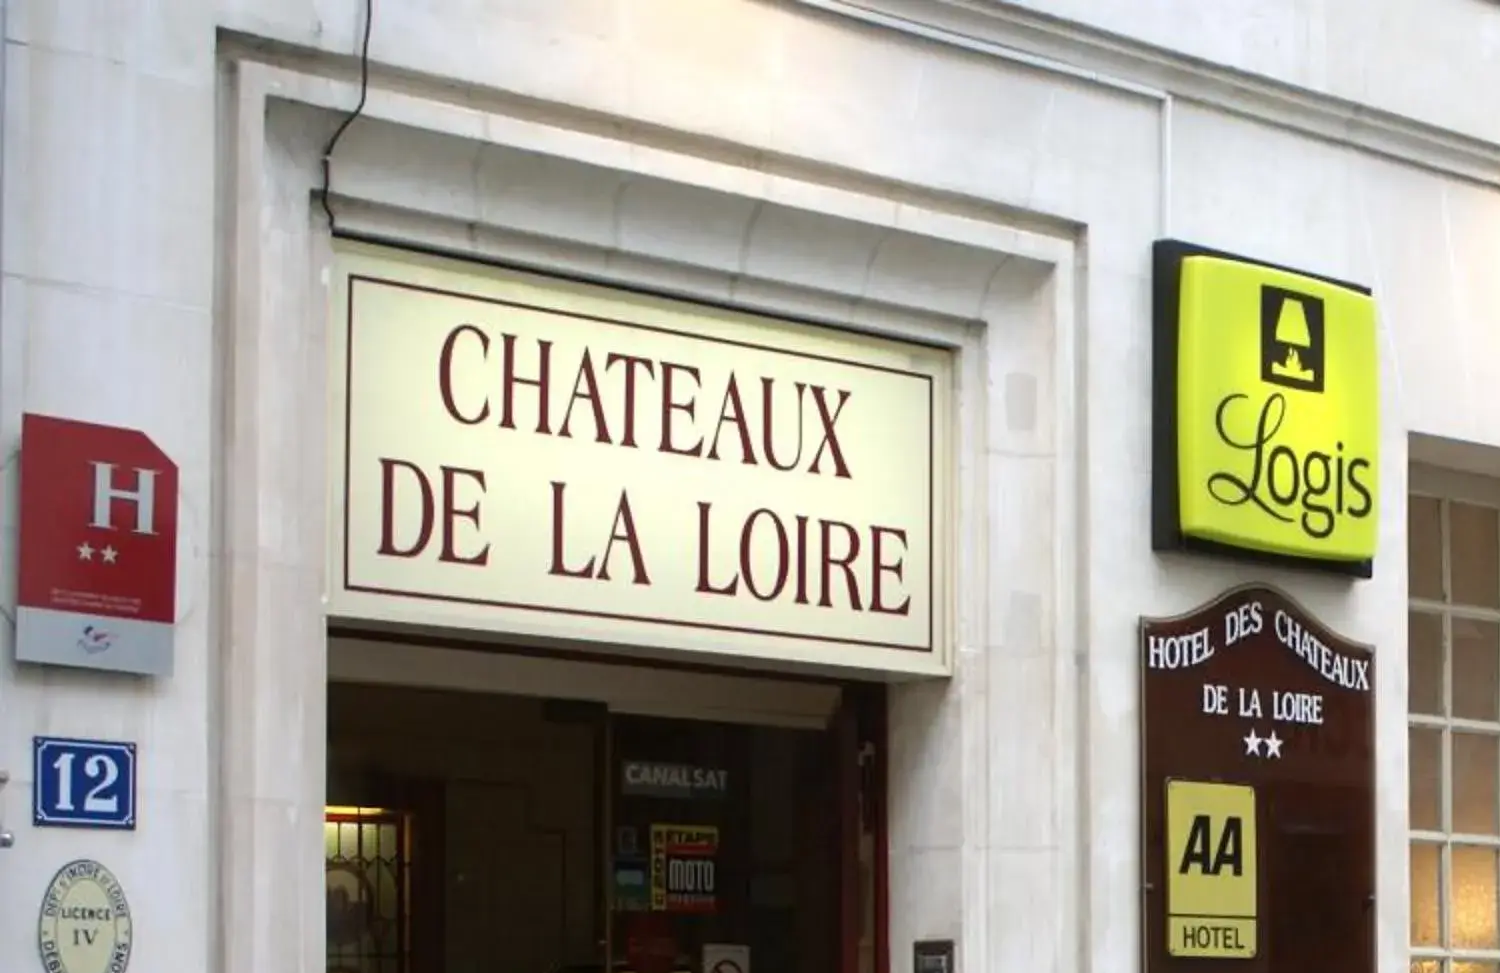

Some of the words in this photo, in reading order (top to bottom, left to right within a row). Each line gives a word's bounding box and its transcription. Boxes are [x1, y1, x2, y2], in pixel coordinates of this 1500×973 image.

[438, 324, 852, 479] CHATEAUX
[1207, 393, 1372, 539] Logis
[88, 460, 162, 536] H
[376, 456, 490, 566] DE
[548, 480, 651, 585] LA
[694, 500, 912, 616] LOIRE
[1149, 627, 1215, 670] HOTEL
[1225, 601, 1263, 645] DES
[1274, 609, 1371, 691] CHATEAUX
[1202, 684, 1228, 715] DE
[1238, 687, 1262, 718] LA
[1273, 691, 1324, 725] LOIRE
[53, 752, 119, 812] 12
[624, 764, 729, 792] CANALSAT
[669, 859, 715, 892] MOTO
[1179, 815, 1244, 878] AA
[61, 908, 111, 922] LICENCE
[72, 928, 98, 946] IV
[1183, 925, 1245, 950] HOTEL
